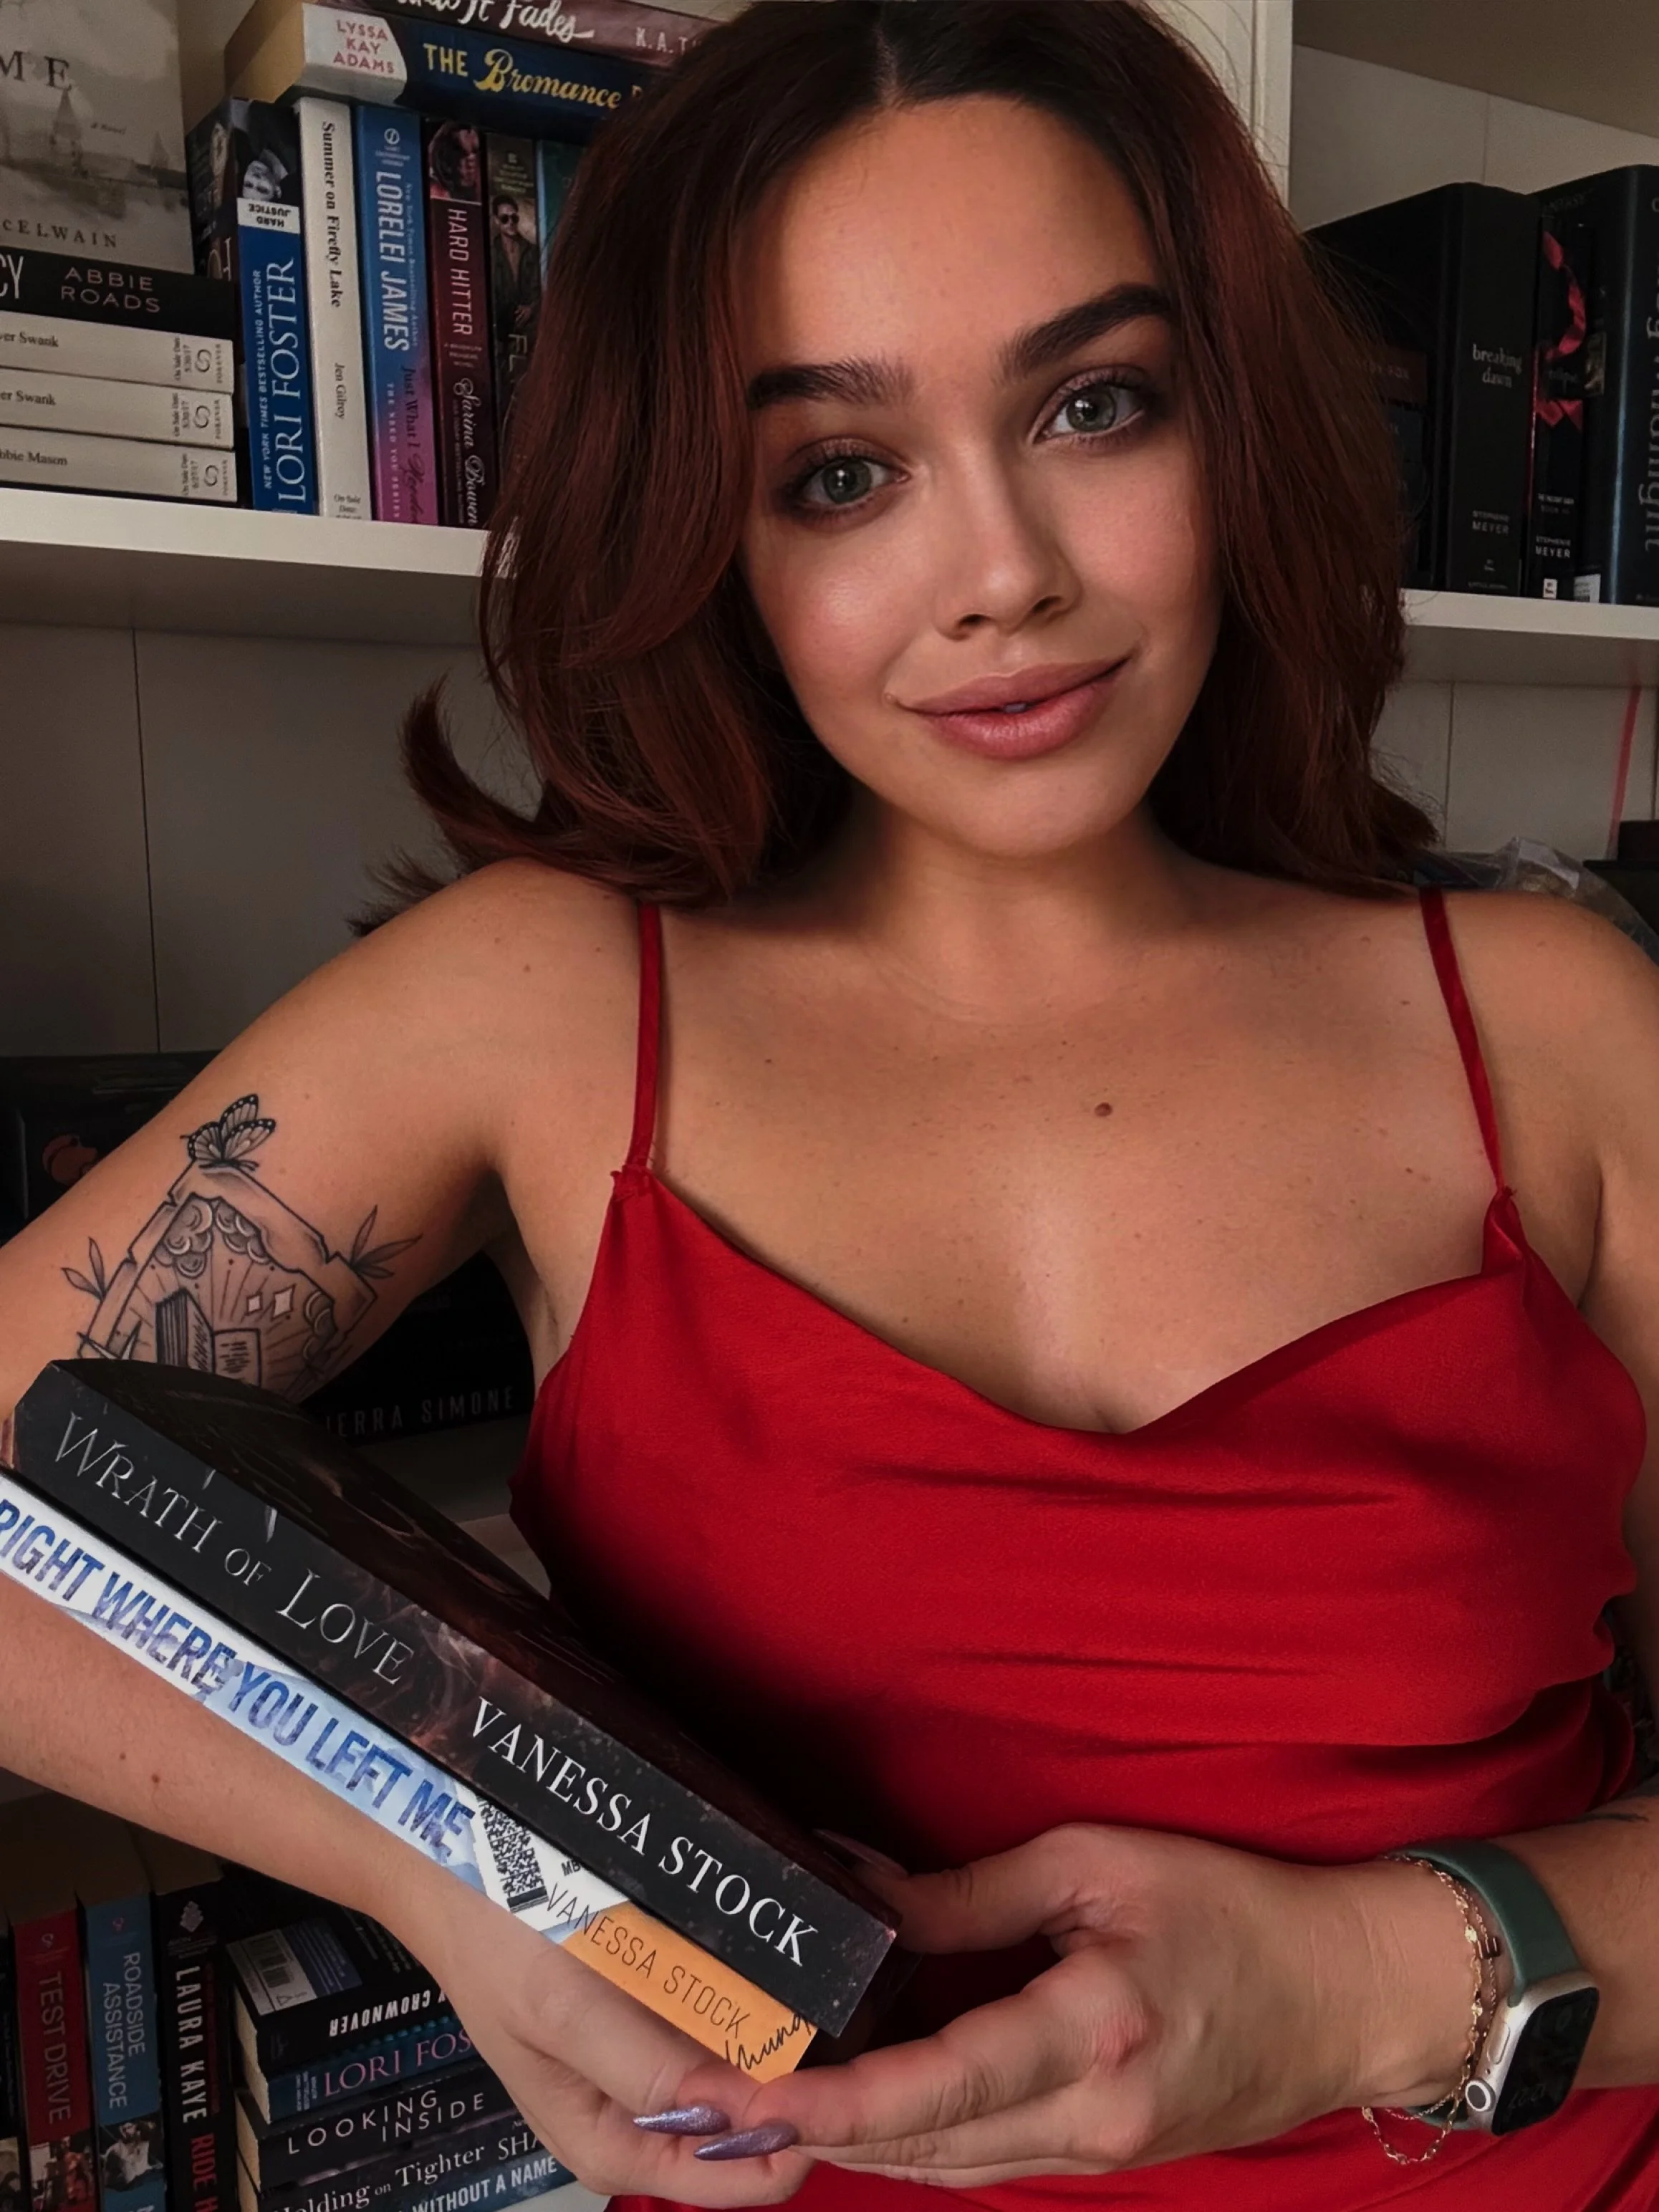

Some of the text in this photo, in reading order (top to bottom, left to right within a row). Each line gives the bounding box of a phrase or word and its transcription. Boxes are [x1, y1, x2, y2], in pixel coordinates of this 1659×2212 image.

[335, 19, 389, 40] LYSSA
[345, 38, 381, 54] KAY
[499, 0, 595, 43] Fades
[332, 49, 395, 74] ADAMS
[423, 43, 622, 110] THE Bromance
[248, 203, 292, 218] JUSTICE
[256, 216, 285, 227] HARD
[321, 121, 342, 308] Summer on Firefly Lake
[375, 170, 406, 264] LORELEI
[447, 208, 470, 262] HARD
[61, 286, 160, 313] ROADS
[64, 266, 153, 291] ABBIE
[252, 270, 263, 314] AUTHOR
[451, 269, 473, 337] HITTER
[266, 258, 301, 400] FOSTER
[380, 269, 410, 352] JAMES
[19, 332, 59, 347] Swank
[255, 319, 266, 393] BESTSELLING
[507, 333, 528, 377] FL
[1471, 343, 1522, 374] breaking
[16, 390, 57, 406] Swank
[401, 365, 418, 395] Just
[1481, 367, 1512, 389] dawn
[260, 398, 269, 428] TIMES
[405, 399, 419, 438] What
[453, 378, 482, 449] Sarina
[264, 470, 272, 489] NEW
[275, 415, 306, 503] LORI
[463, 455, 486, 526] Bowen
[1471, 520, 1509, 535] MEYER
[1535, 545, 1571, 559] MEYER
[420, 1385, 514, 1425] SIMONE
[54, 1411, 415, 1685] WRATH OF LOVE
[0, 1499, 476, 1857] RIGHT WHERE YOU LEFT ME
[468, 1696, 818, 1967] VANESSA STOCK
[546, 1882, 751, 2040] VANESSA STOCK
[39, 1971, 66, 2039] TEST
[122, 1952, 146, 2057] ROADSIDE
[175, 1965, 205, 2049] LAURA
[328, 1988, 431, 2038] CROWNOVER
[102, 1982, 128, 2110] ASSISTANCE
[44, 2042, 72, 2125] DRIVE
[180, 2059, 208, 2123] KAYE
[322, 2050, 401, 2098] LORI
[288, 2089, 438, 2155] LOOKING
[381, 2092, 486, 2143] INSIDE
[190, 2132, 218, 2191] RIDE
[374, 2180, 392, 2196] on
[395, 2145, 486, 2188] Tighter
[412, 2155, 558, 2212] WITHOUT A NAME
